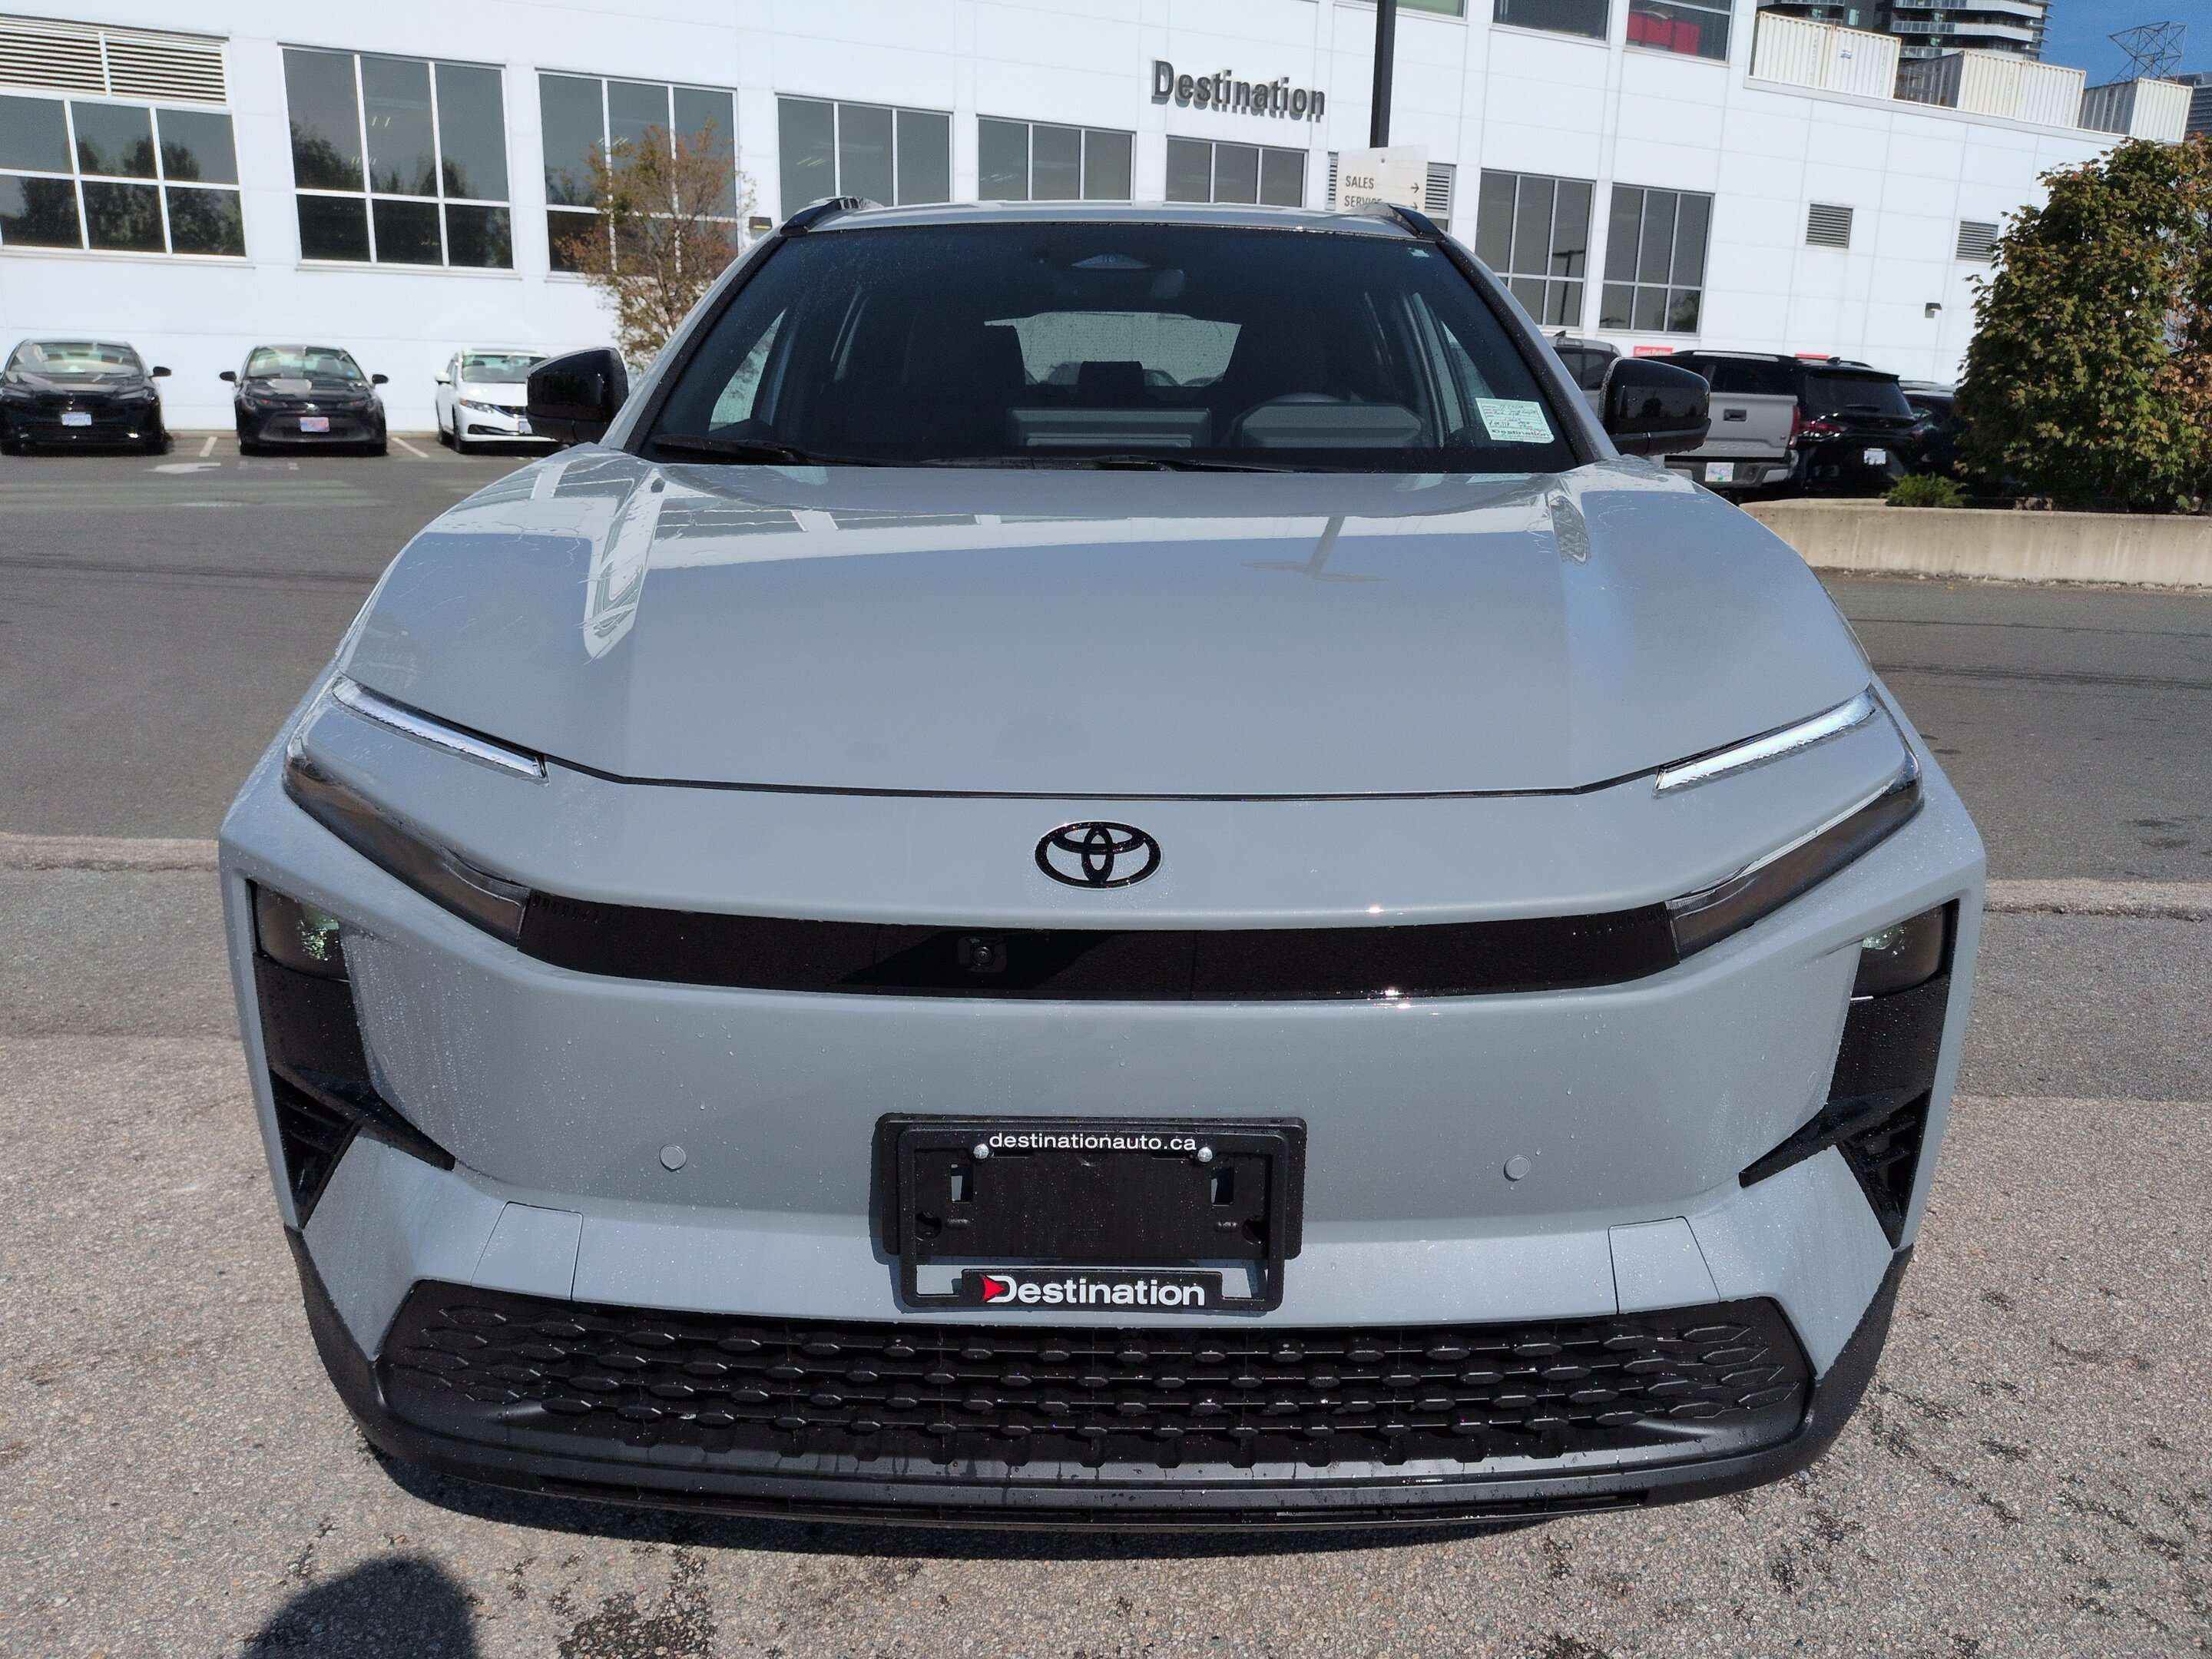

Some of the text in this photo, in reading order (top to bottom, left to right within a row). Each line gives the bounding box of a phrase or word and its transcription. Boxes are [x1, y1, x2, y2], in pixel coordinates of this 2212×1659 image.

[1153, 60, 1326, 116] Destination
[1345, 175, 1375, 190] SALES
[1343, 195, 1383, 207] SERVI
[988, 1132, 1197, 1151] destinationauto.ca
[986, 1274, 1206, 1306] Destination
